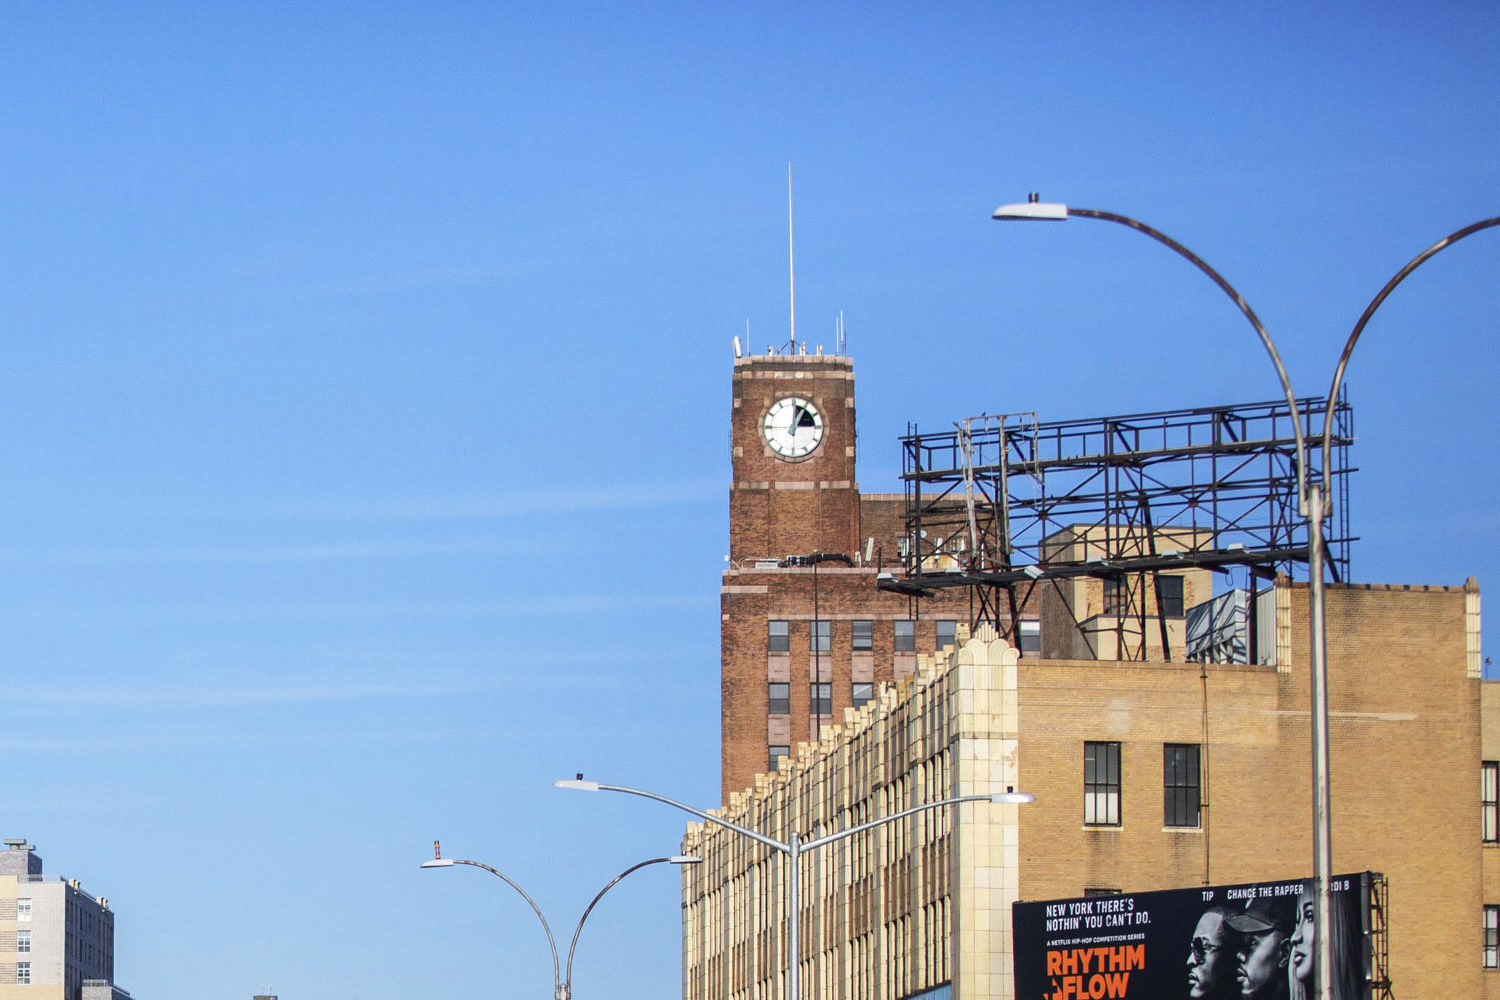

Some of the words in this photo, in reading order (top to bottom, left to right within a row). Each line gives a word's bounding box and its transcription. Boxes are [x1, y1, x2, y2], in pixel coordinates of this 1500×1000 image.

[1202, 891, 1213, 901] TIP
[1227, 888, 1256, 900] CHANCE
[1258, 886, 1272, 897] THE
[1275, 884, 1304, 896] RAPPER
[1046, 904, 1066, 917] NEW
[1069, 902, 1093, 915] YORK
[1096, 898, 1134, 913] THERE'S
[1046, 917, 1081, 931] NOTHIN'
[1085, 915, 1102, 928] YOU
[1106, 913, 1132, 927] CAN'T
[1136, 911, 1151, 924] DO.
[1093, 935, 1127, 943] COMPETITION
[1047, 944, 1145, 976] RHYTHM
